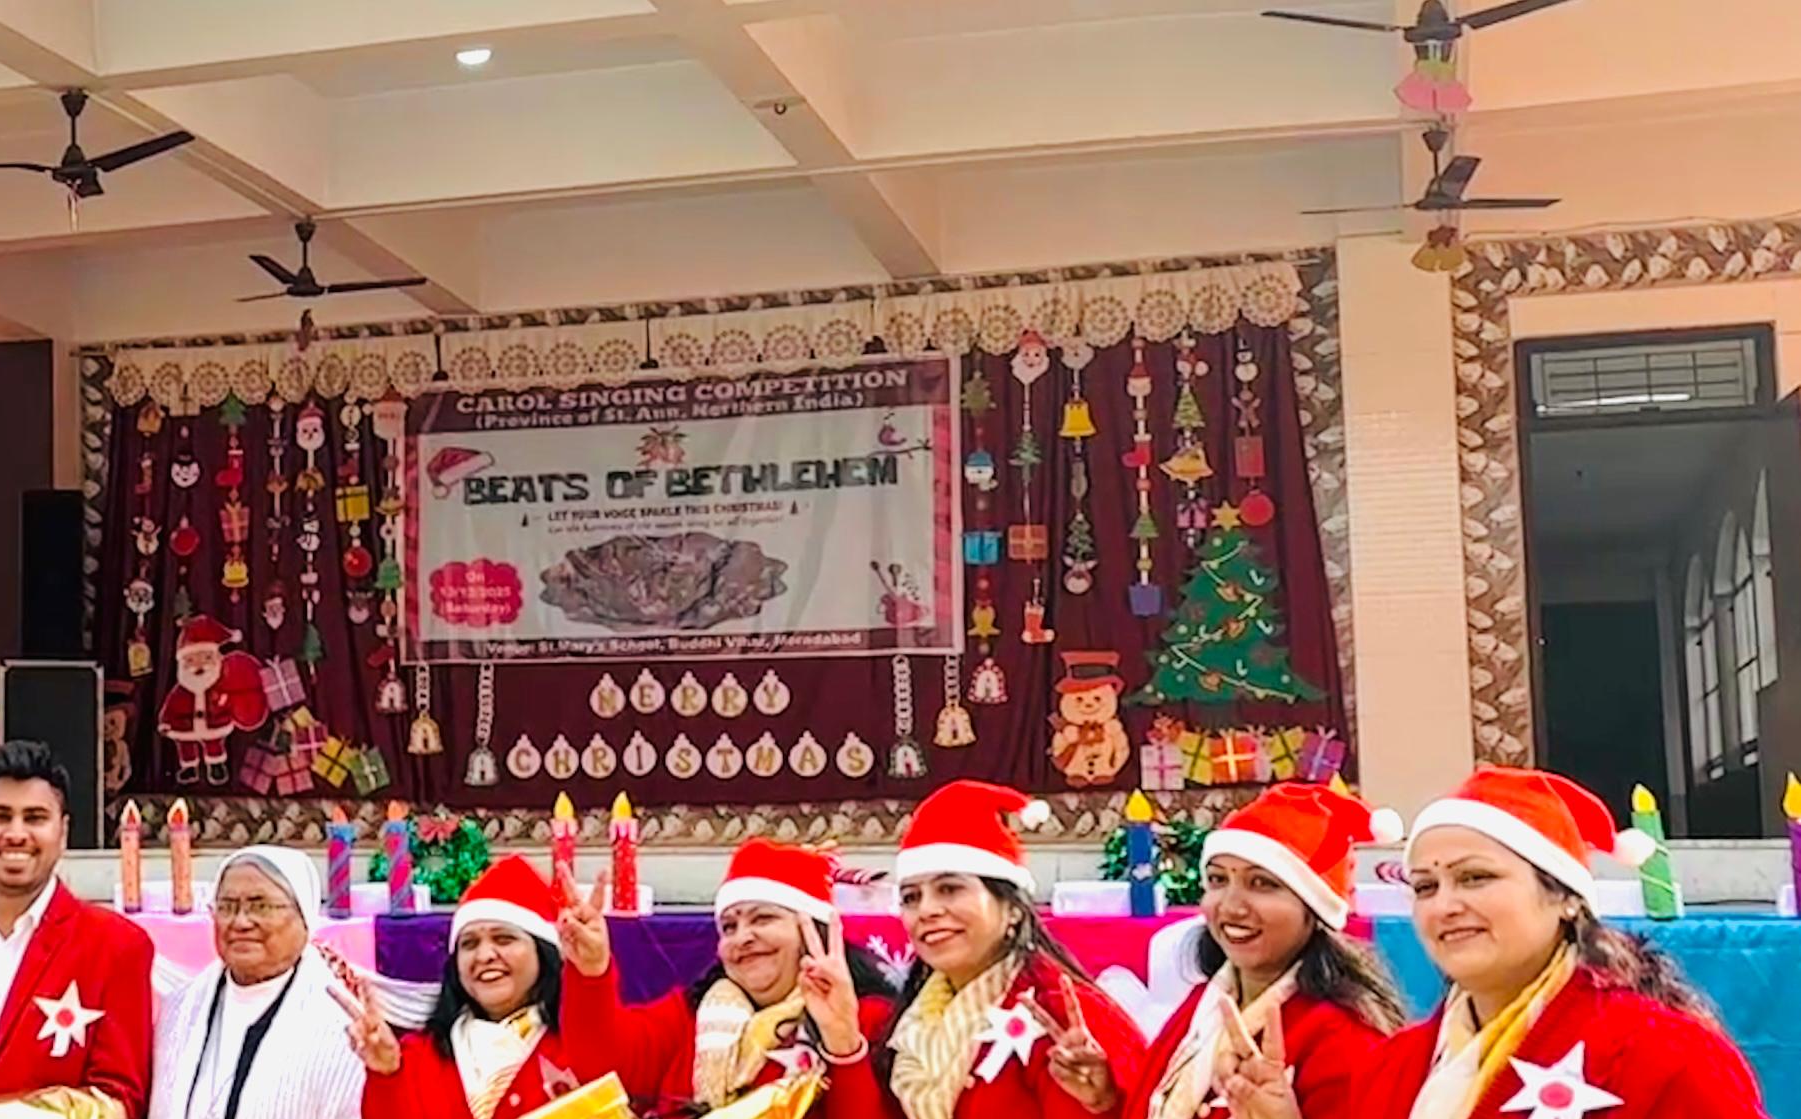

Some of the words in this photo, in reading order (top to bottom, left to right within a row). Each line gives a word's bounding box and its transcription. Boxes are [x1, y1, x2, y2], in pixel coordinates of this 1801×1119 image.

[456, 393, 552, 414] CAROL
[558, 385, 686, 409] SINGING
[694, 369, 908, 400] COMPETITION
[475, 411, 574, 428] (Province
[577, 409, 598, 424] of
[692, 397, 789, 418] Northern
[792, 391, 864, 411] India)
[463, 473, 590, 506] BEATS
[606, 469, 658, 499] OF
[665, 454, 898, 498] BETHLEHEM
[603, 507, 637, 520] VOICE
[596, 681, 781, 714] MERRY
[513, 743, 867, 774] CHRISTMAS
